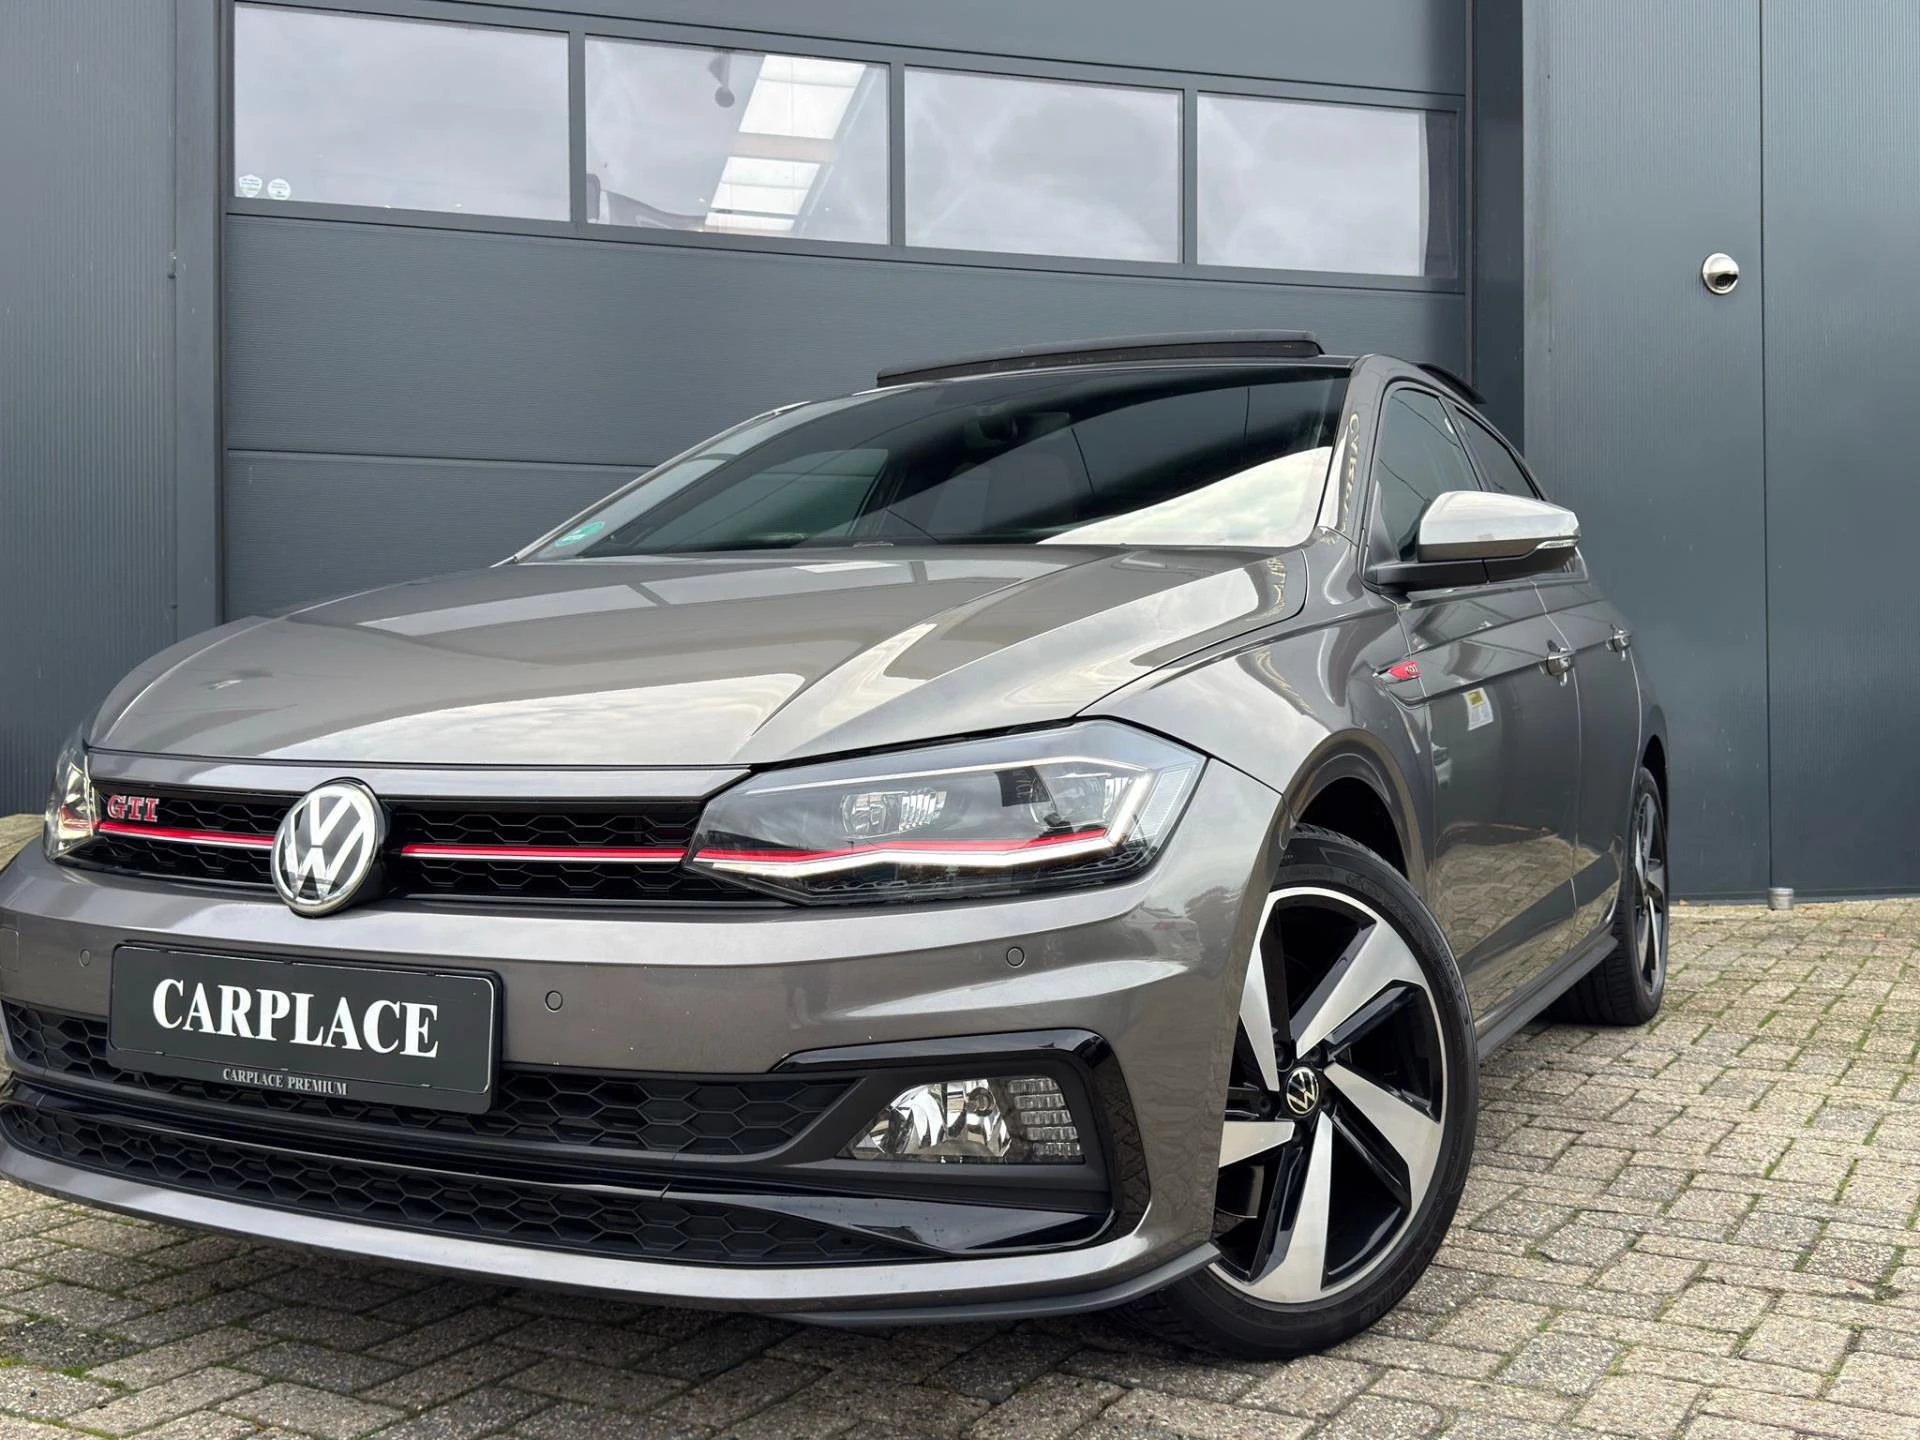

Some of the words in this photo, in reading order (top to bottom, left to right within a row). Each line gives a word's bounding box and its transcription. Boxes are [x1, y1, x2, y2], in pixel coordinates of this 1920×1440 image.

[107, 795, 159, 822] GTI
[152, 978, 438, 1058] CARPLACE
[222, 1068, 284, 1088] CARPLACE
[287, 1076, 348, 1096] PREMIUM
